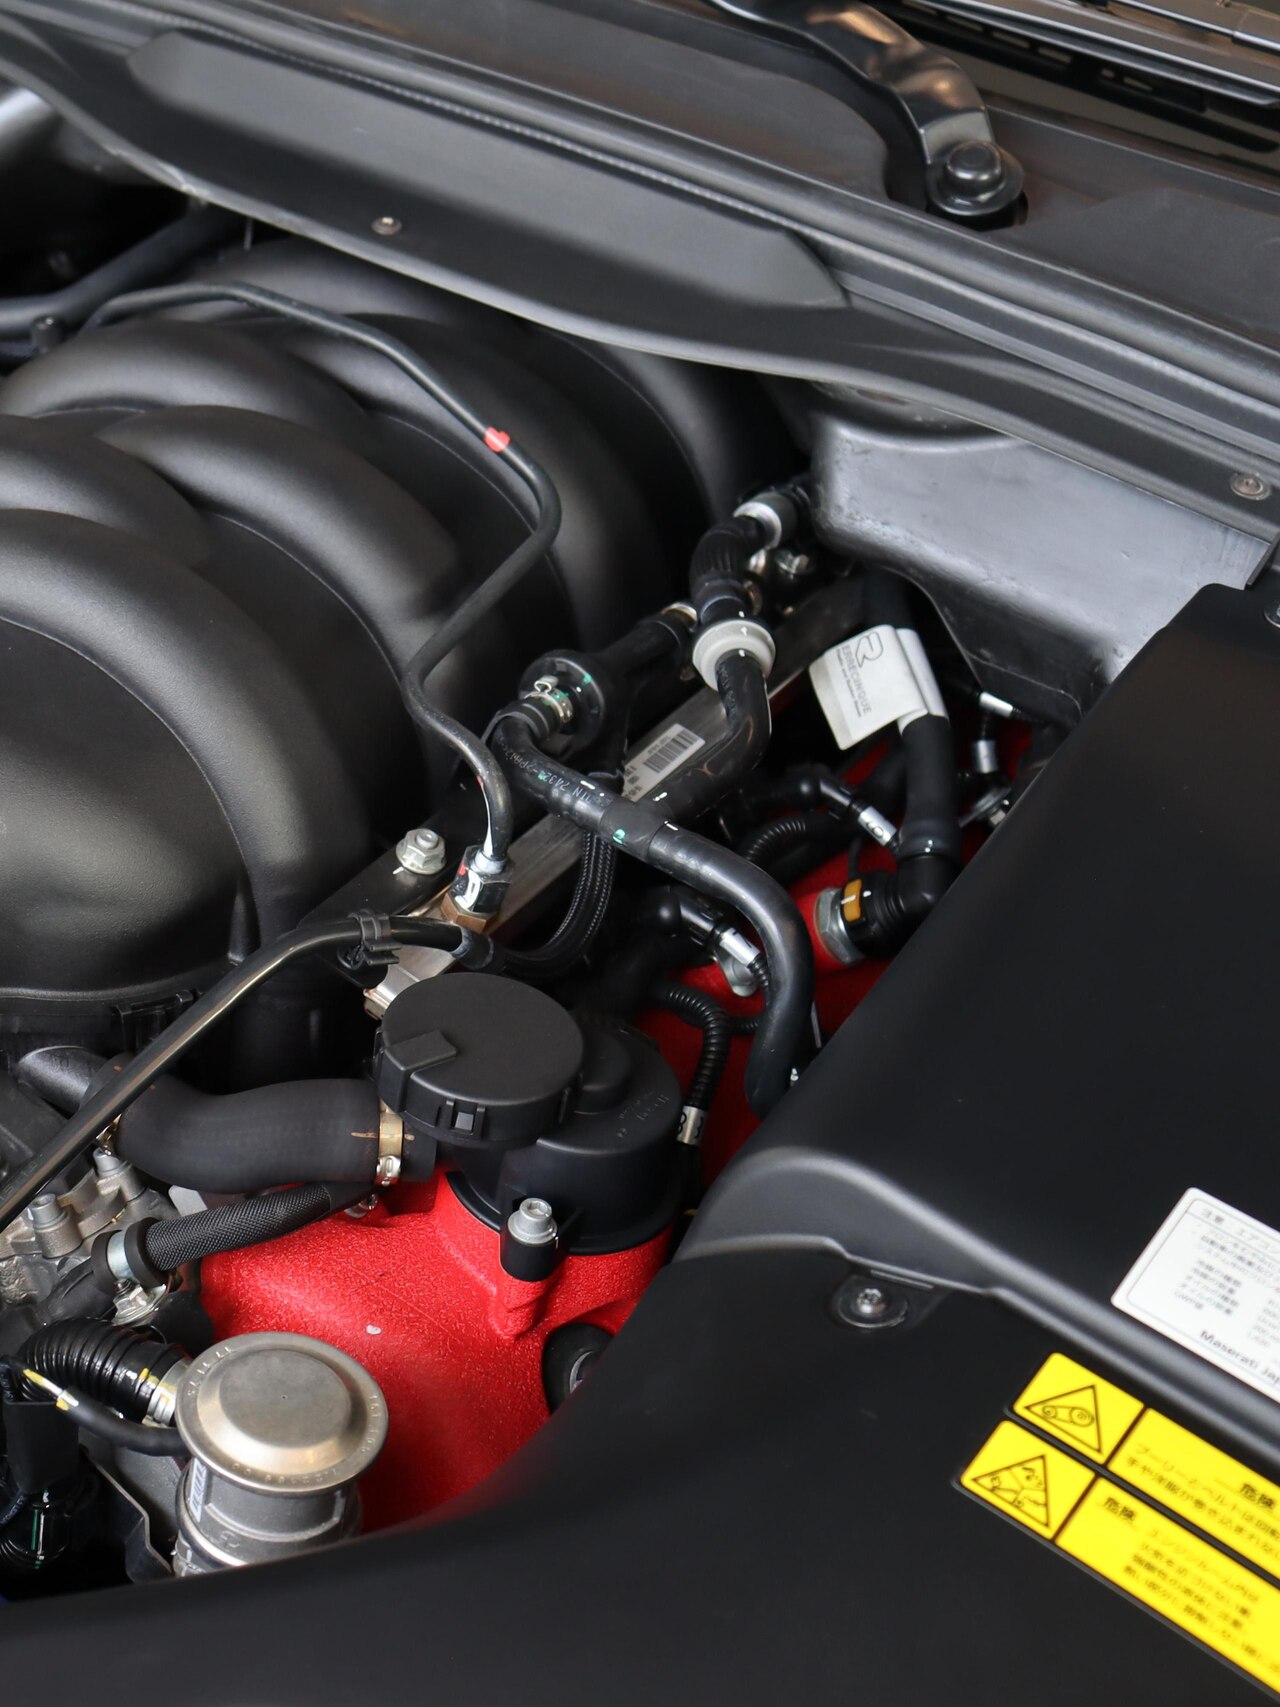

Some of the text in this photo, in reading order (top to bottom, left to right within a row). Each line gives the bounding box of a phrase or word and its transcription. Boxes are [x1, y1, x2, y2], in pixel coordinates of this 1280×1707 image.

[1199, 1330, 1259, 1369] Maserati
[1103, 1497, 1137, 1524] 危険
[1239, 1483, 1276, 1511] 危険
